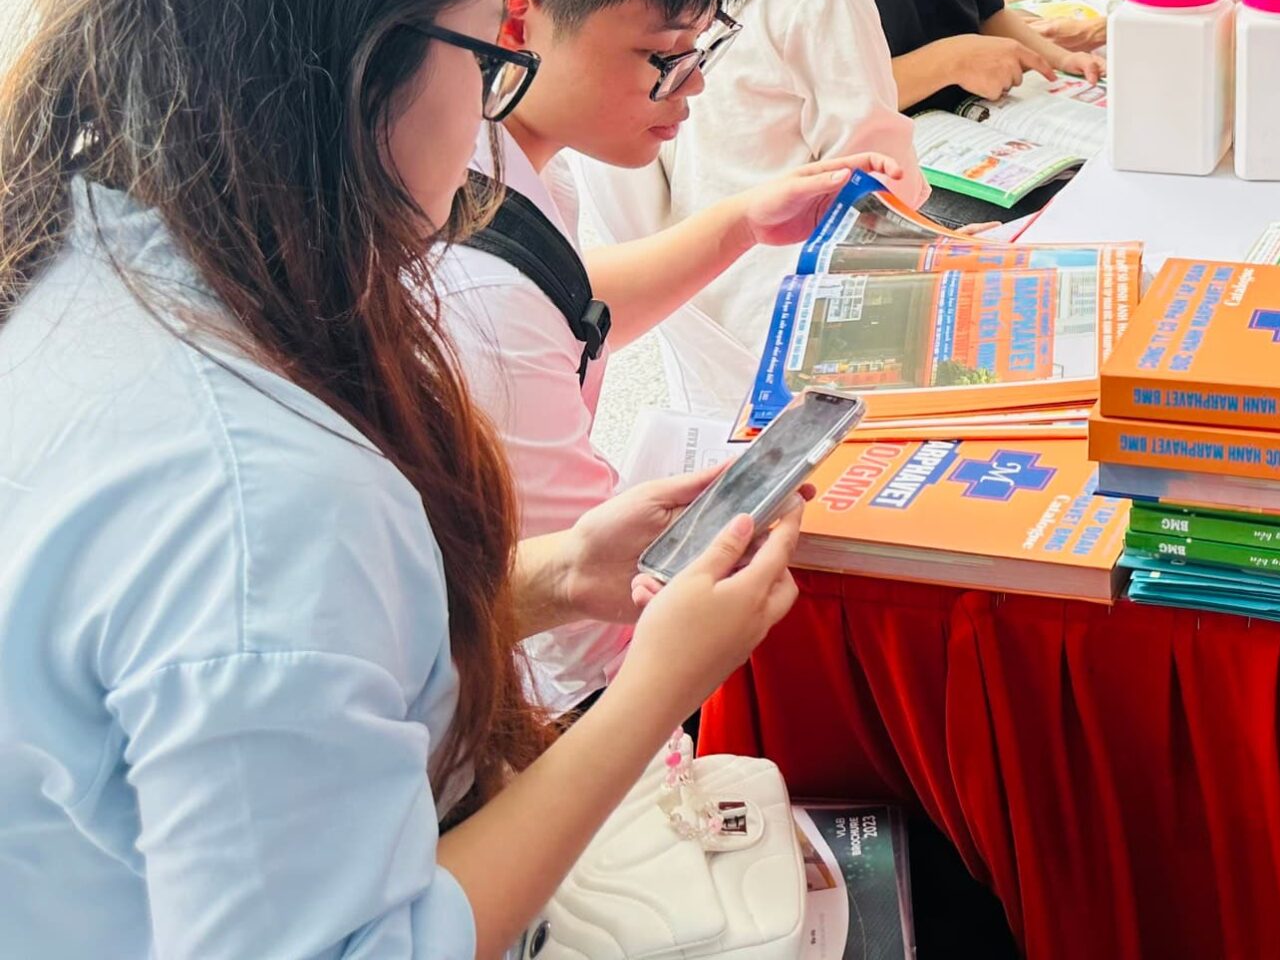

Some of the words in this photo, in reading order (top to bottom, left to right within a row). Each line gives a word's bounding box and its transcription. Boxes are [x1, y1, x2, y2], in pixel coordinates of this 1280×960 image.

[1133, 388, 1161, 404] BMG
[1166, 390, 1238, 411] MARPHAVET
[1243, 394, 1275, 415] HẠNH
[1120, 435, 1148, 452] BMG
[1151, 438, 1224, 459] MARPHAVET
[875, 440, 955, 507] ARPHAVET
[835, 817, 845, 839] VLAB
[852, 816, 862, 856] BROCHURE
[864, 814, 877, 839] 2023
